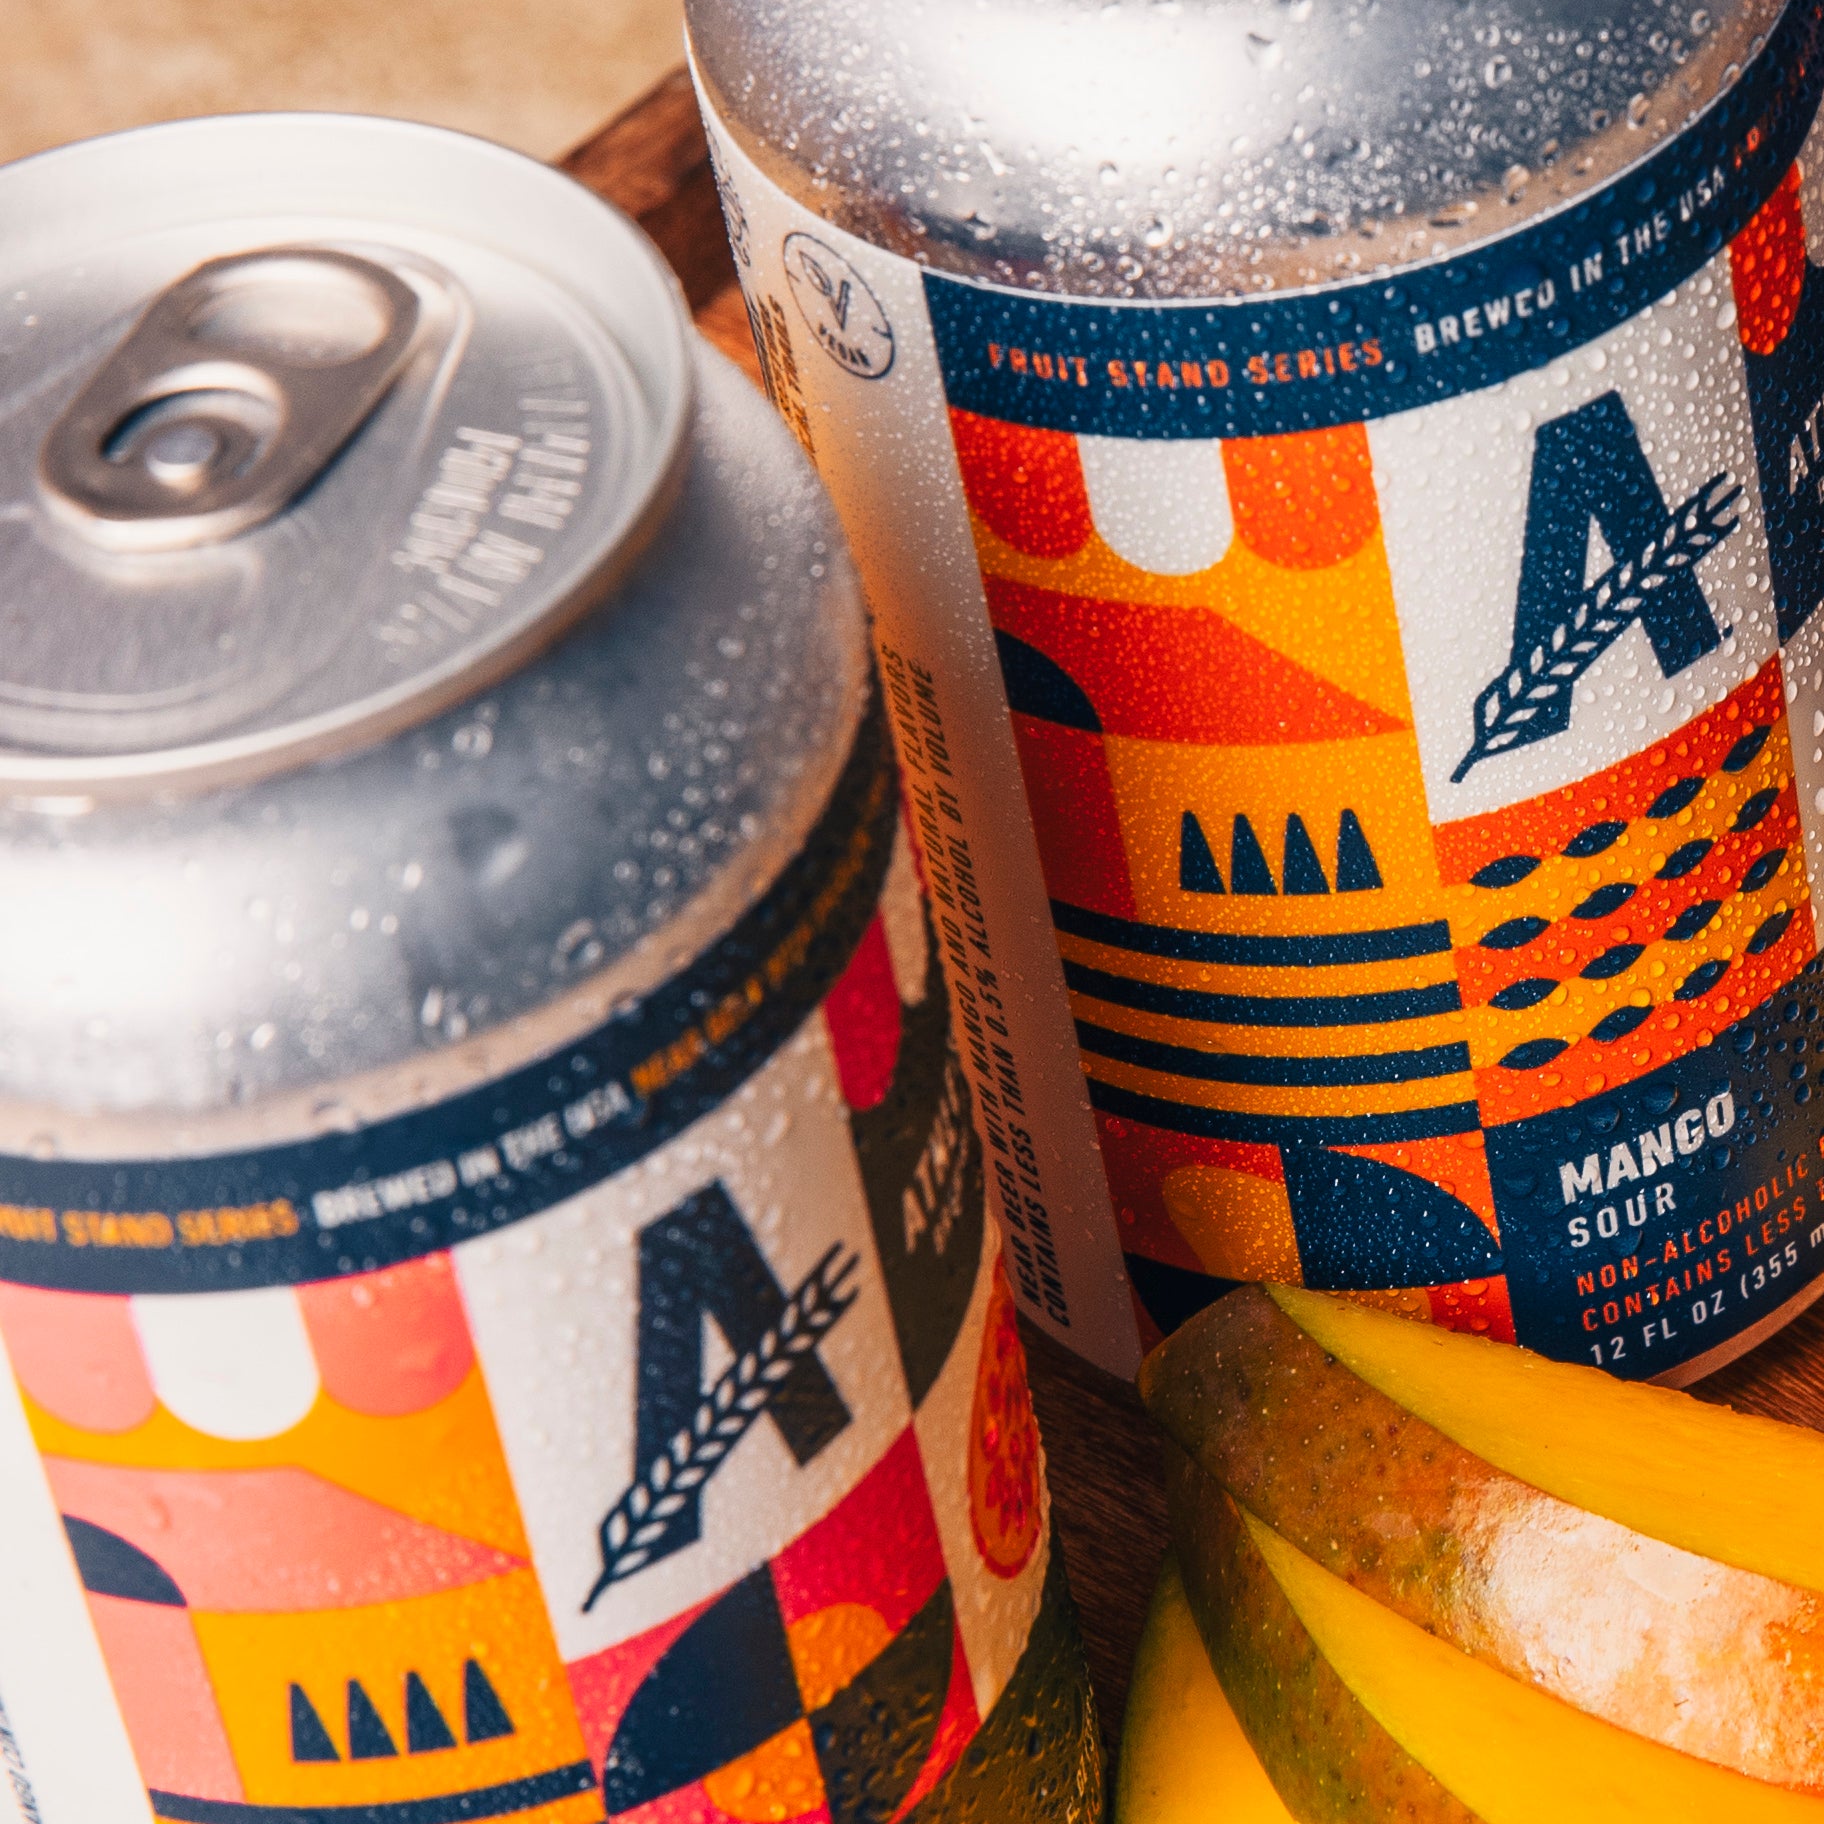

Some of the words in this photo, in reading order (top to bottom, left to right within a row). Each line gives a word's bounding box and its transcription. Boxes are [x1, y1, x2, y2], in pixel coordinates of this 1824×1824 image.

[988, 341, 1091, 387] FRUIT
[1106, 359, 1230, 390] STAND
[1246, 337, 1384, 386] SERIES
[1412, 277, 1557, 355] BREWED
[1568, 252, 1603, 295] IN
[1617, 218, 1669, 266] THE
[1678, 167, 1727, 224] USA
[881, 643, 927, 776] FLAVORS
[907, 657, 955, 779] VOLUME
[910, 782, 957, 911] NATURAL
[934, 780, 964, 826] BY
[940, 914, 969, 978] AND
[948, 835, 993, 961] ALCOHOL
[954, 978, 994, 1080] MANGO
[989, 1041, 1026, 1117] THAN
[312, 1158, 459, 1230] BREWED
[459, 1144, 502, 1186] IN
[501, 1112, 565, 1172] THE
[976, 1080, 1011, 1155] WITH
[1007, 1121, 1043, 1194] LESS
[1558, 1090, 1737, 1206] MANGO
[993, 1160, 1027, 1232] BEER
[1567, 1181, 1679, 1249] SOUR
[1576, 1153, 1810, 1297] NON-ALCOHOLIC
[1010, 1232, 1042, 1309] NEAR
[1022, 1194, 1072, 1330] CONTAINS
[1581, 1247, 1733, 1333] CONTAINS
[1744, 1195, 1808, 1257] LESS
[1588, 1333, 1627, 1367] 12
[1642, 1314, 1679, 1348] FL
[1691, 1285, 1727, 1327] OZ
[1739, 1239, 1801, 1300] (355
